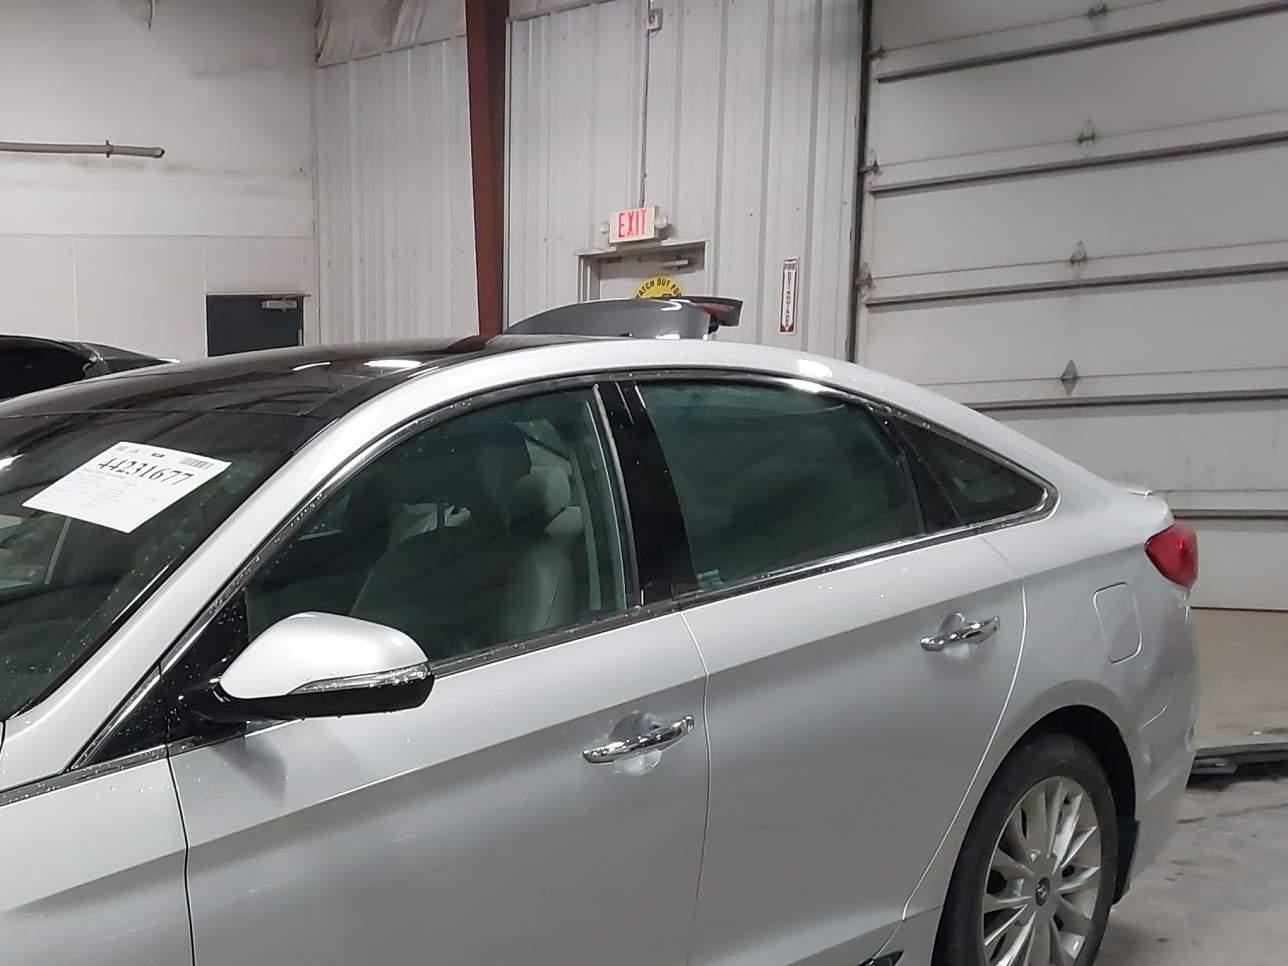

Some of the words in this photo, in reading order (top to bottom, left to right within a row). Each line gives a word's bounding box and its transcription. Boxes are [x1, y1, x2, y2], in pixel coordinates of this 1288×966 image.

[618, 209, 647, 238] EXIT
[636, 280, 655, 298] ATCH
[657, 278, 671, 287] OUT
[98, 457, 194, 485] 44231677
